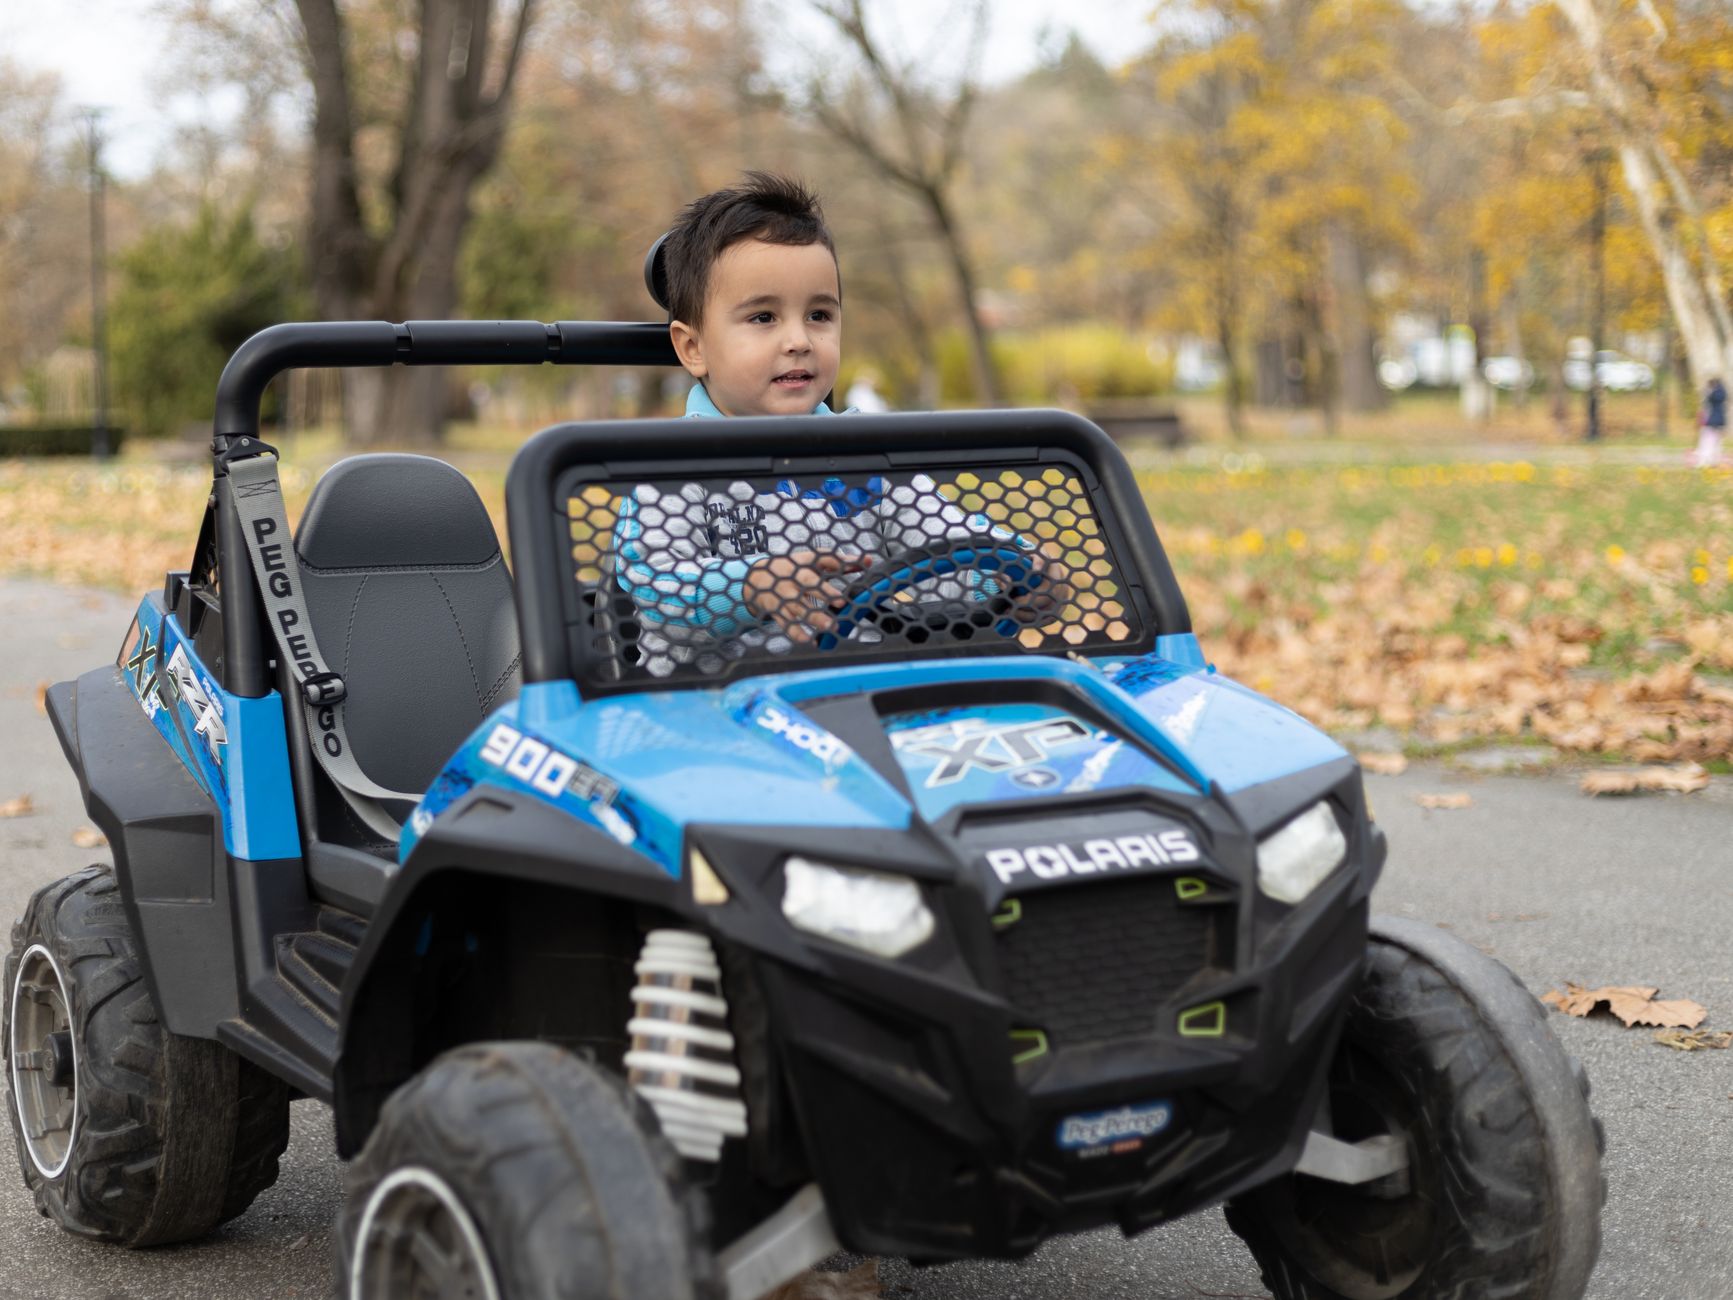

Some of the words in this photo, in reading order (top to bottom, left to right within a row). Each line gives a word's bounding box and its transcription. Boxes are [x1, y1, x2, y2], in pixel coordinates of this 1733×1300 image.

[252, 517, 292, 598] PEG
[166, 643, 228, 766] RZR
[479, 723, 578, 798] 900
[908, 717, 1091, 787] XP
[985, 830, 1199, 884] POLARIS
